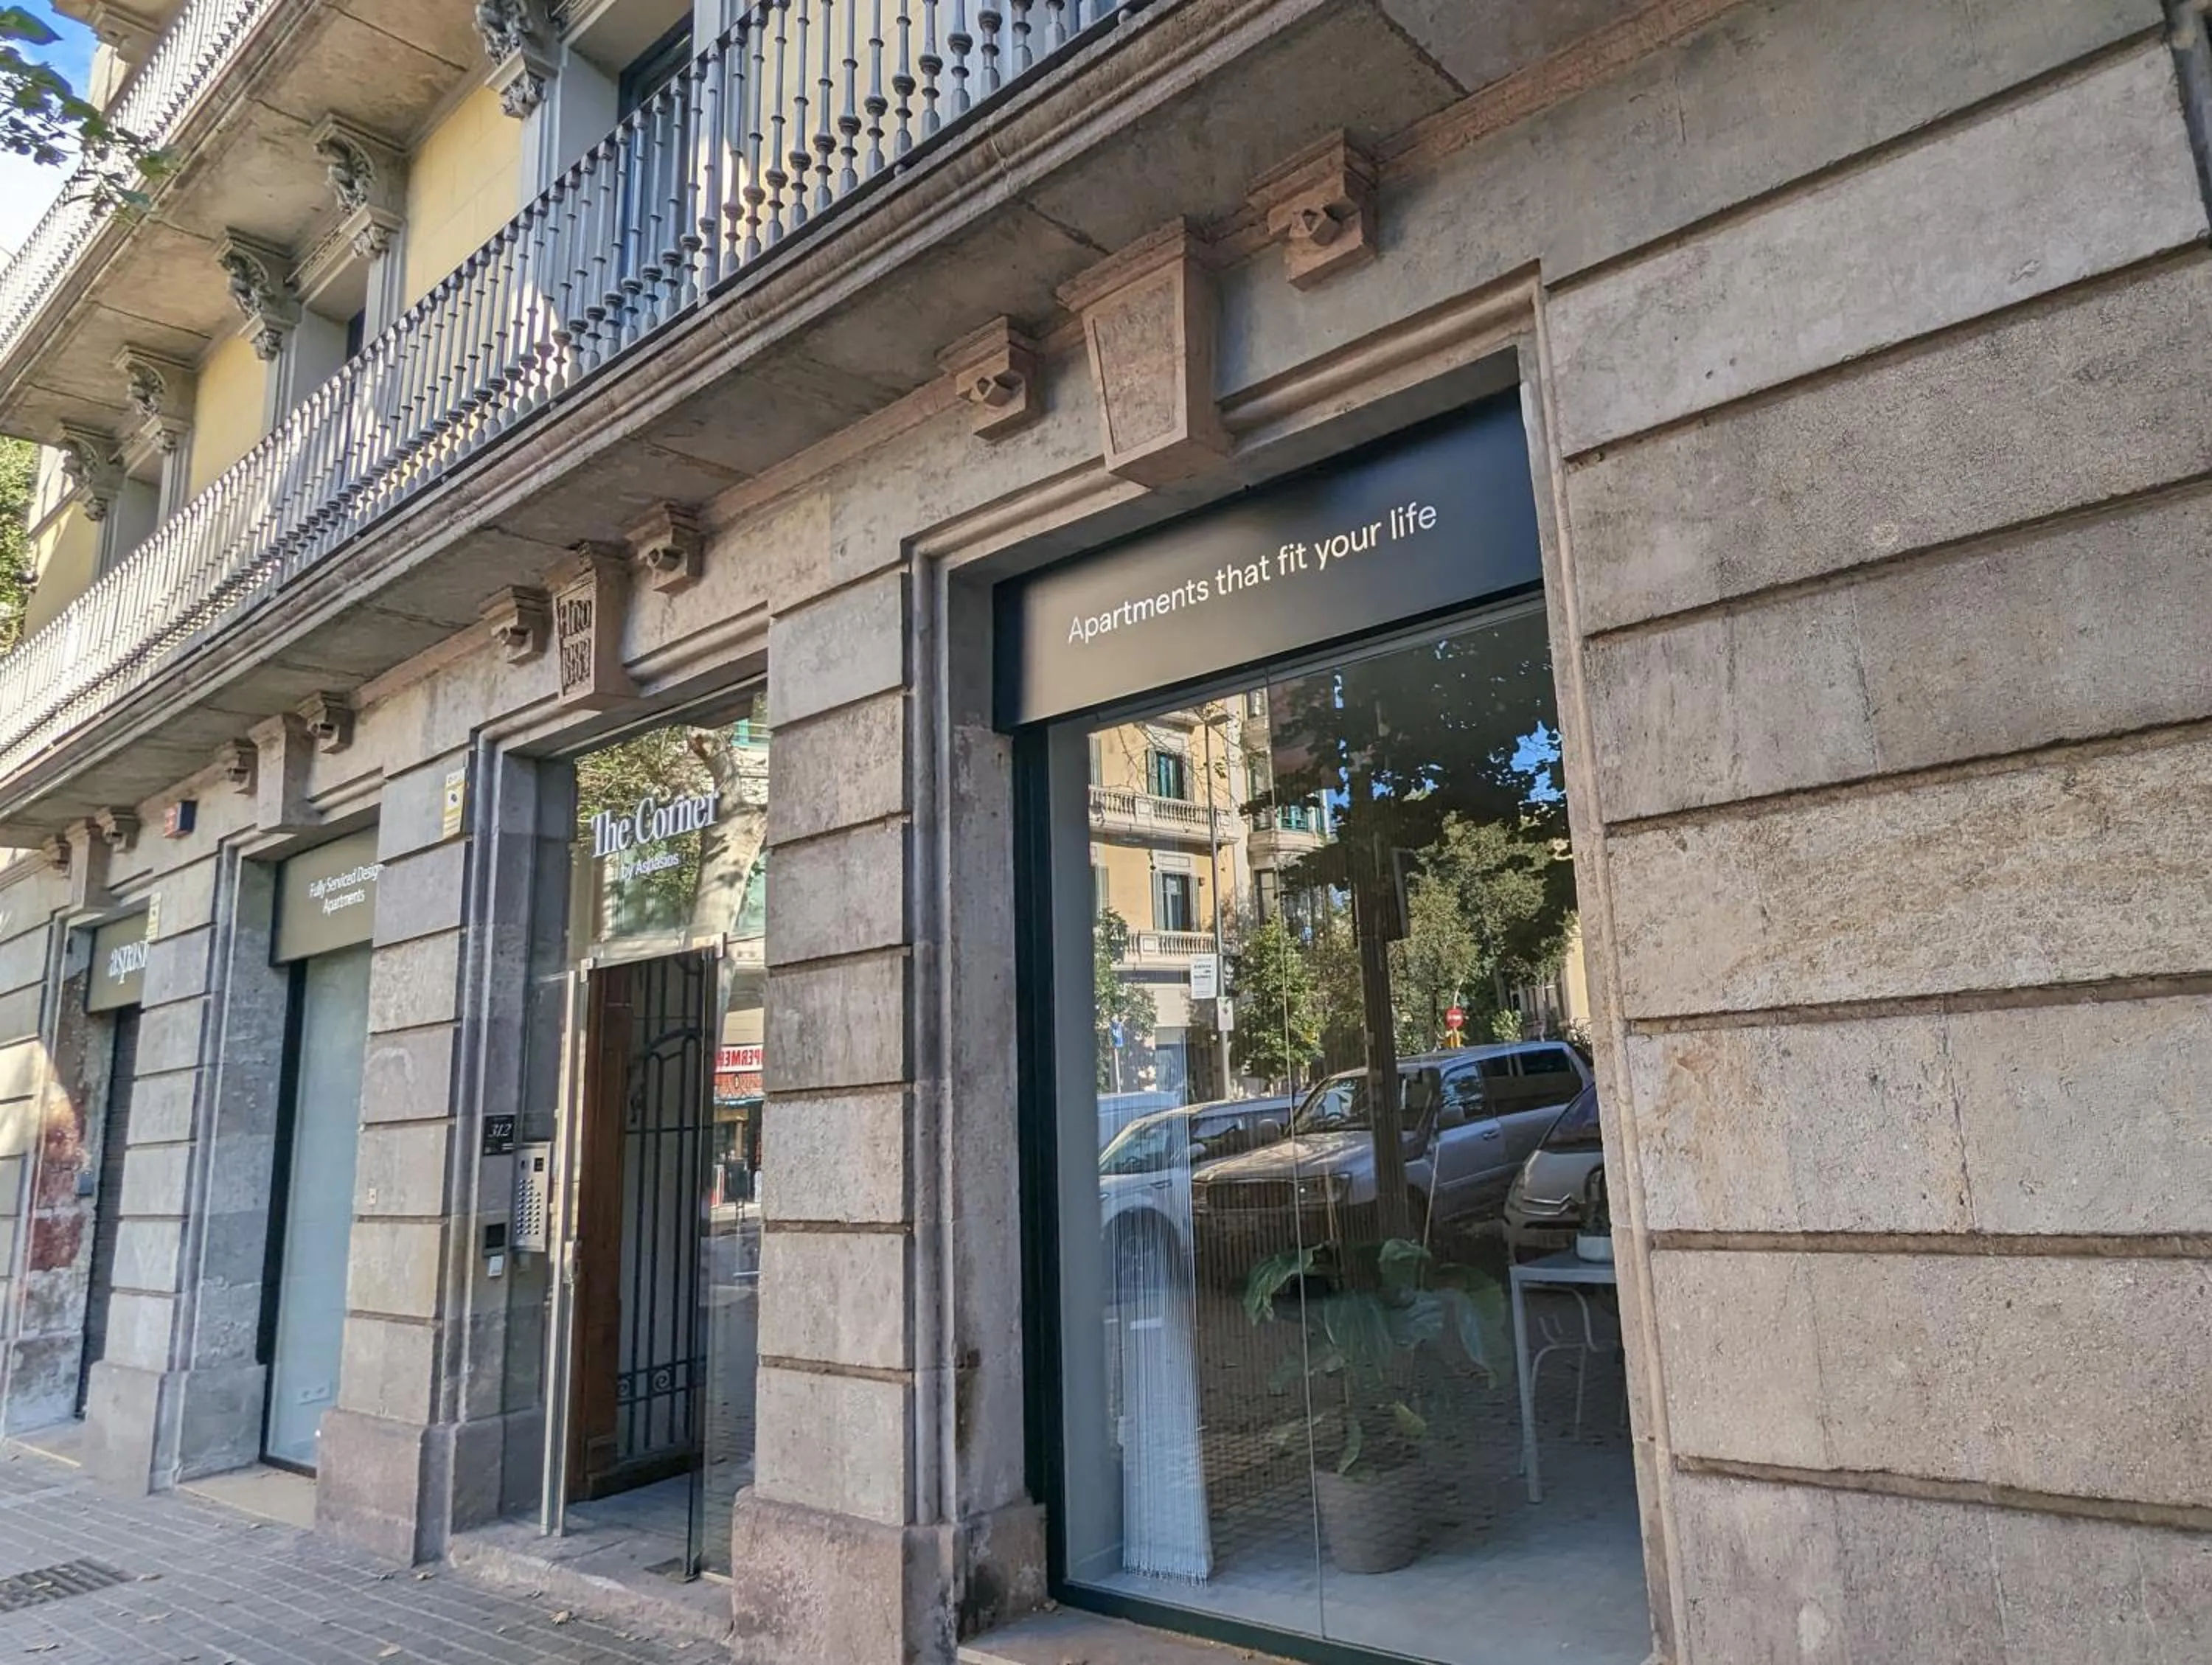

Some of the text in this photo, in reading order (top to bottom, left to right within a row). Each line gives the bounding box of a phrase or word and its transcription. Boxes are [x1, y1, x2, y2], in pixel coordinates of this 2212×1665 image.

[1068, 501, 1437, 644] Apartments that fit your life
[591, 790, 720, 858] The Corner
[621, 852, 678, 881] by Aspasios
[309, 880, 325, 899] Fully
[326, 868, 357, 893] Serviced
[322, 888, 365, 917] Apartments
[487, 1123, 512, 1138] 312
